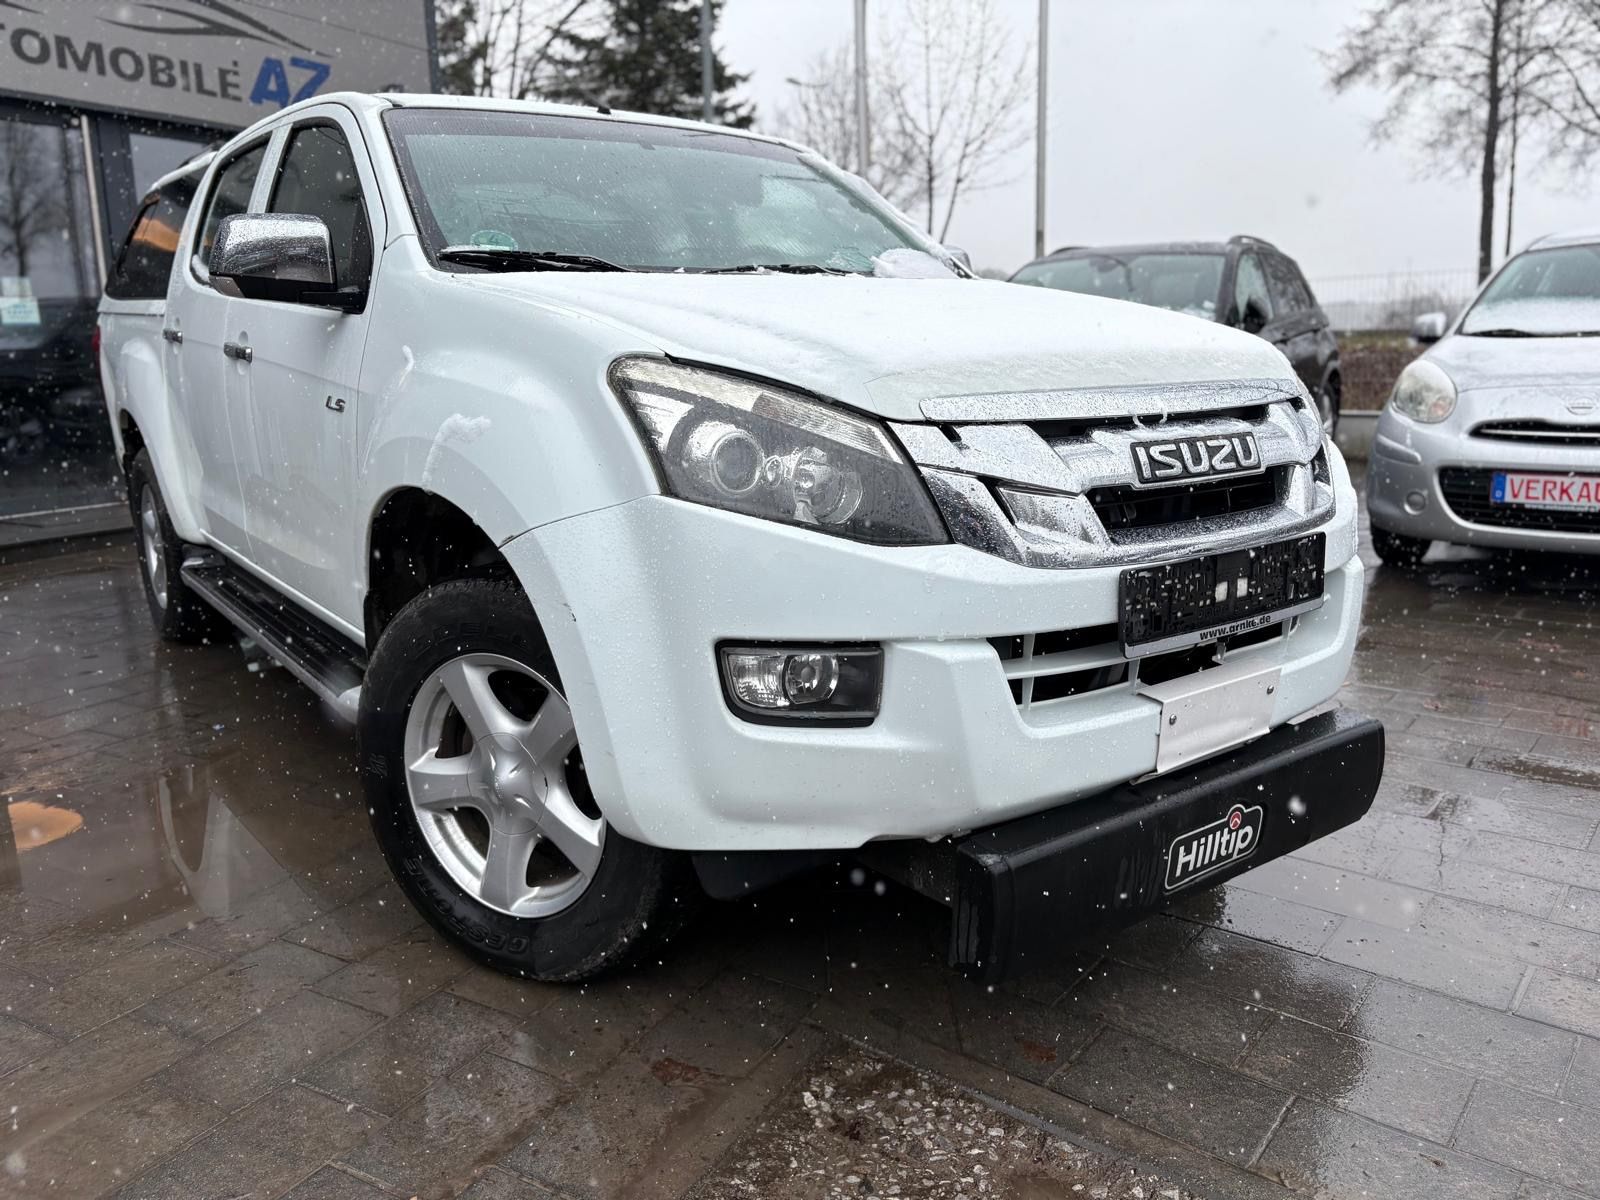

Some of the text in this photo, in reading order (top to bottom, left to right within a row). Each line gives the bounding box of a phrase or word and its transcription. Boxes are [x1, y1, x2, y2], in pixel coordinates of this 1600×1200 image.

[0, 23, 331, 110] OMOBILĖ AZ
[325, 395, 346, 413] LS
[1136, 436, 1260, 479] ISUZU
[1175, 811, 1254, 877] Hilltip
